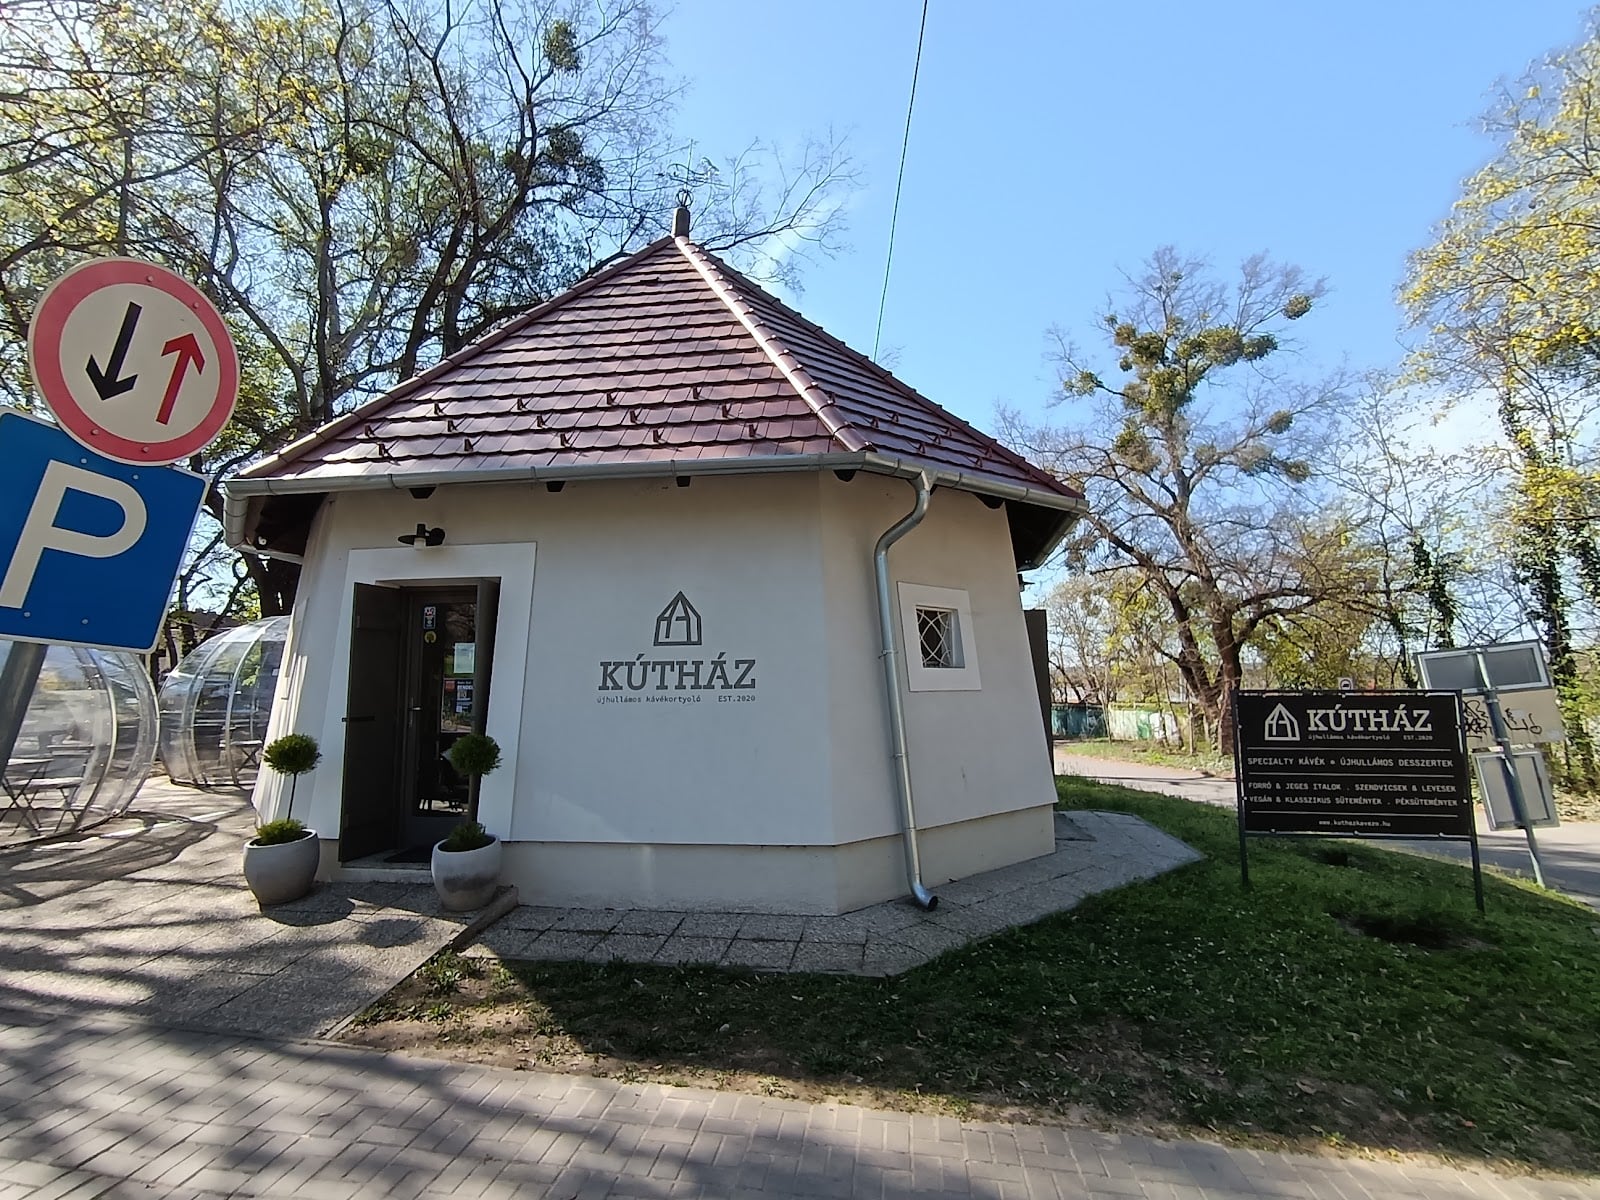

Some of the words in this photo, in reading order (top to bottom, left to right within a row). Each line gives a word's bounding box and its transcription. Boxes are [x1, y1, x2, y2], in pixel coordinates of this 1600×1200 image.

[0, 459, 148, 609] P
[598, 652, 756, 691] KÚTHÁZ
[646, 695, 702, 705] kávékortyoló
[718, 695, 756, 703] EST.2020
[1306, 703, 1433, 732] KÚTHÁZ
[1247, 757, 1294, 766] SPECIALTY
[1298, 756, 1325, 766] KÁVÉK
[1340, 756, 1394, 767] ÚJHULLÁMOS
[1398, 758, 1454, 768] DESSZERTEK
[1248, 781, 1272, 790] FORRÓ
[1285, 782, 1309, 790] JEGES
[1312, 783, 1341, 791] ITALOK
[1354, 783, 1408, 792] SZENDVICSEK
[1421, 784, 1457, 793] LEVESEK
[1249, 794, 1273, 803] VEGÁN
[1285, 796, 1332, 804] KLASSZIKUS
[1335, 796, 1382, 805] SÜTEMÉNYEK
[1395, 797, 1458, 807] PÉKSÜTEMÉNYEK
